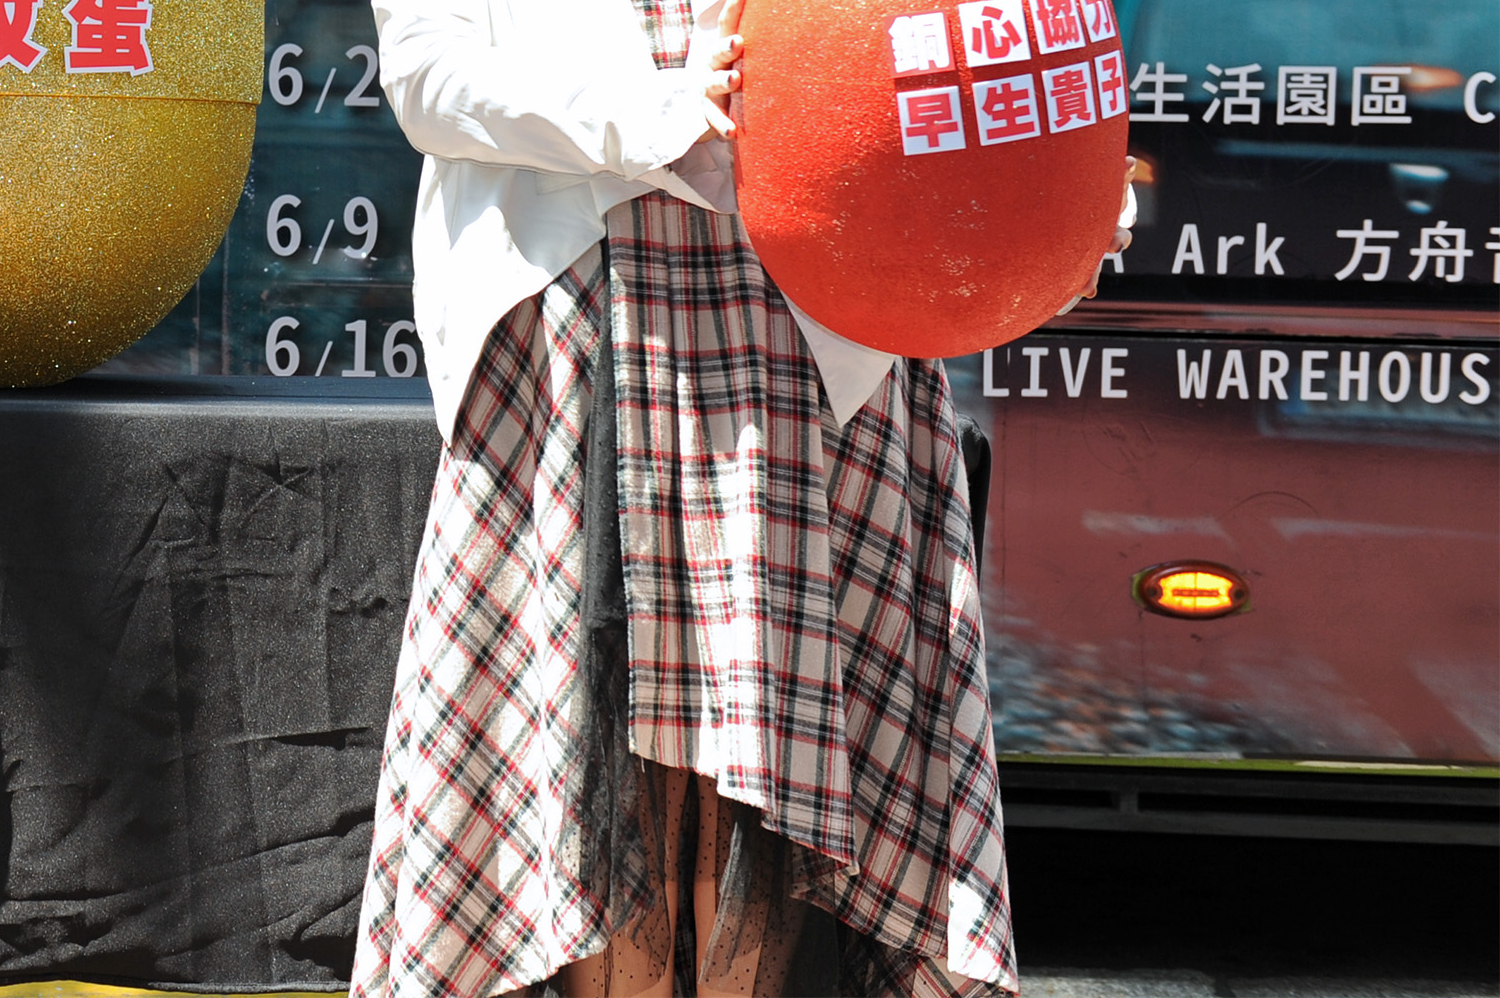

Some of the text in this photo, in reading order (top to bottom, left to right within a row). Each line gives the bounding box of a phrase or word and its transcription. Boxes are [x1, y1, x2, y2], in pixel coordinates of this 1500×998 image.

[904, 55, 1123, 149] 早生貴子
[1130, 62, 1413, 126] 生活園區
[266, 193, 379, 265] 6/9
[1171, 218, 1500, 284] Ark 方舟
[265, 315, 418, 378] 6/16
[981, 346, 1491, 406] LIVE WAREHOUS
